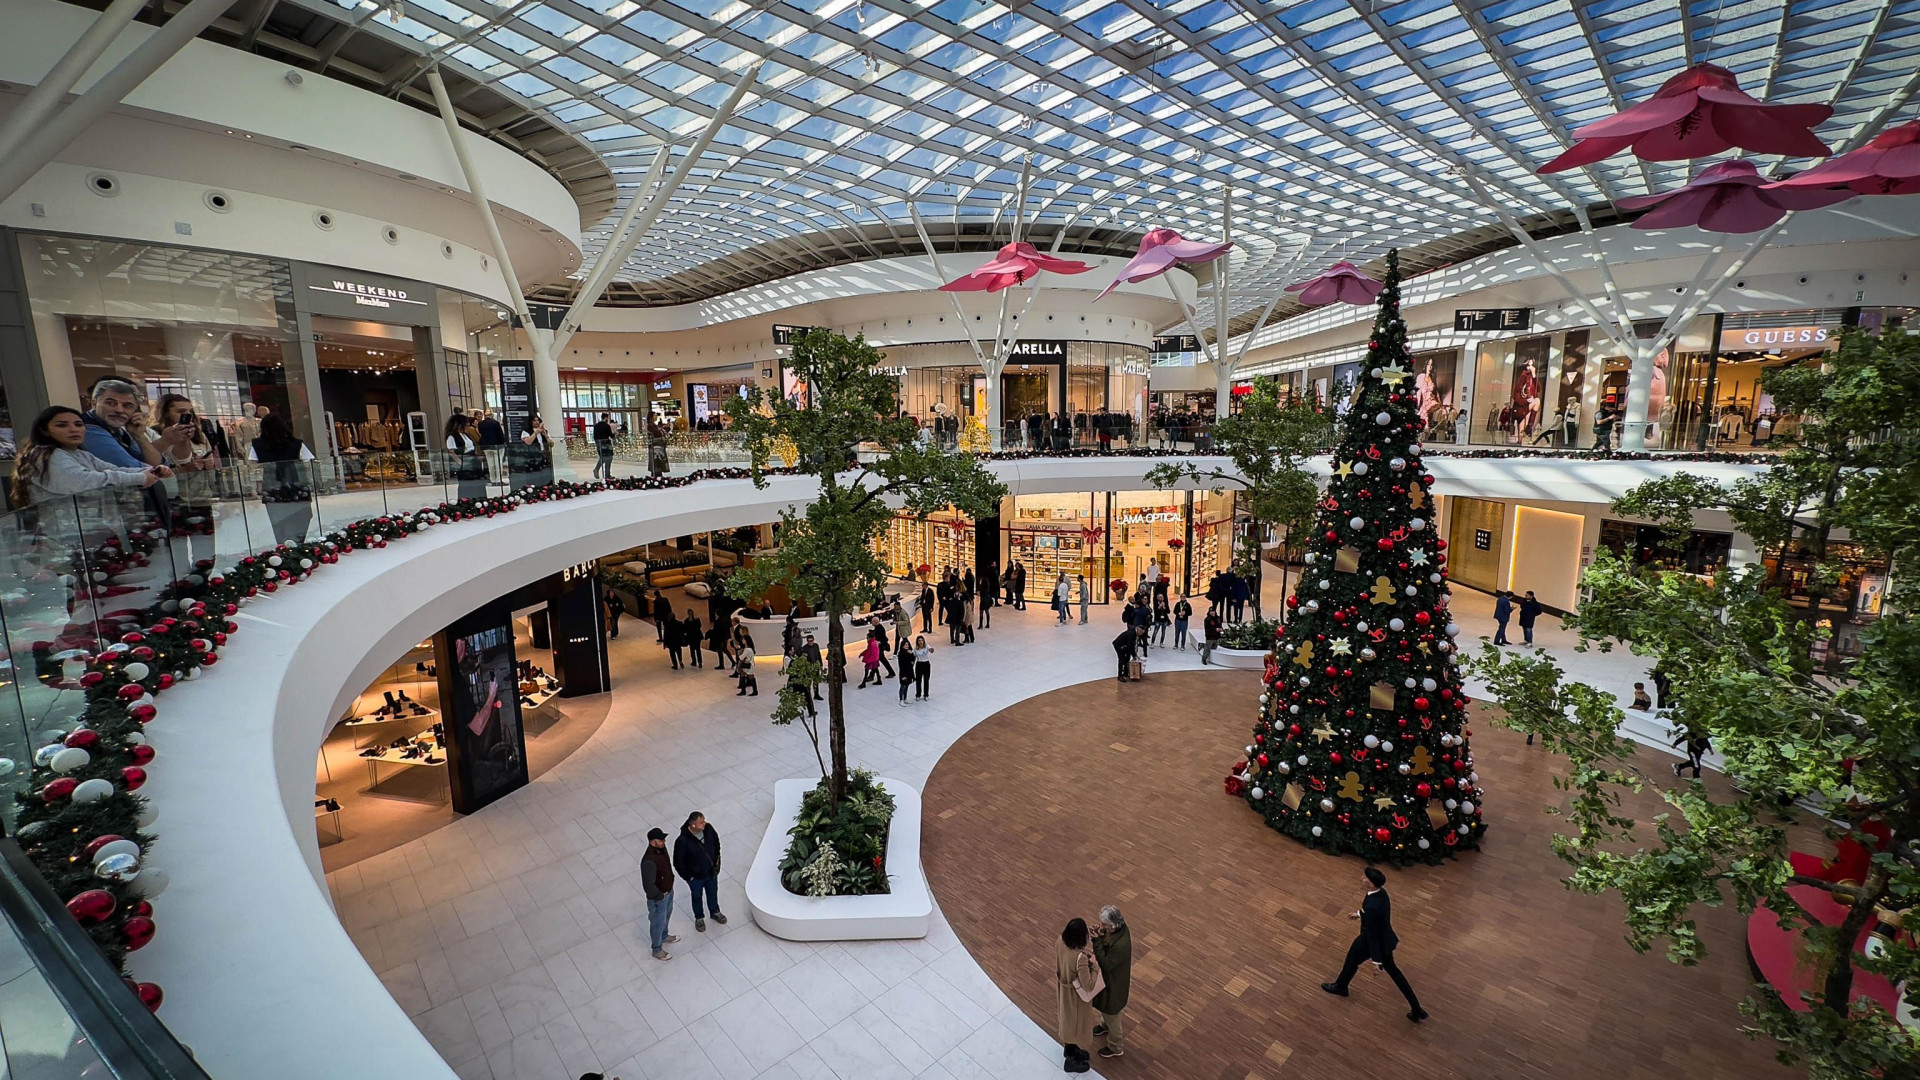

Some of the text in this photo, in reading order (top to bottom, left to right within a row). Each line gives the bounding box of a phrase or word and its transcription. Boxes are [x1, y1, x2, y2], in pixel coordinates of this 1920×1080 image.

[332, 280, 407, 299] WEEKEND
[355, 295, 390, 308] MaxMara
[1462, 317, 1468, 329] 1
[779, 331, 784, 343] 1
[1744, 328, 1827, 344] GUESS
[1116, 512, 1182, 525] LAMA OPTICAL
